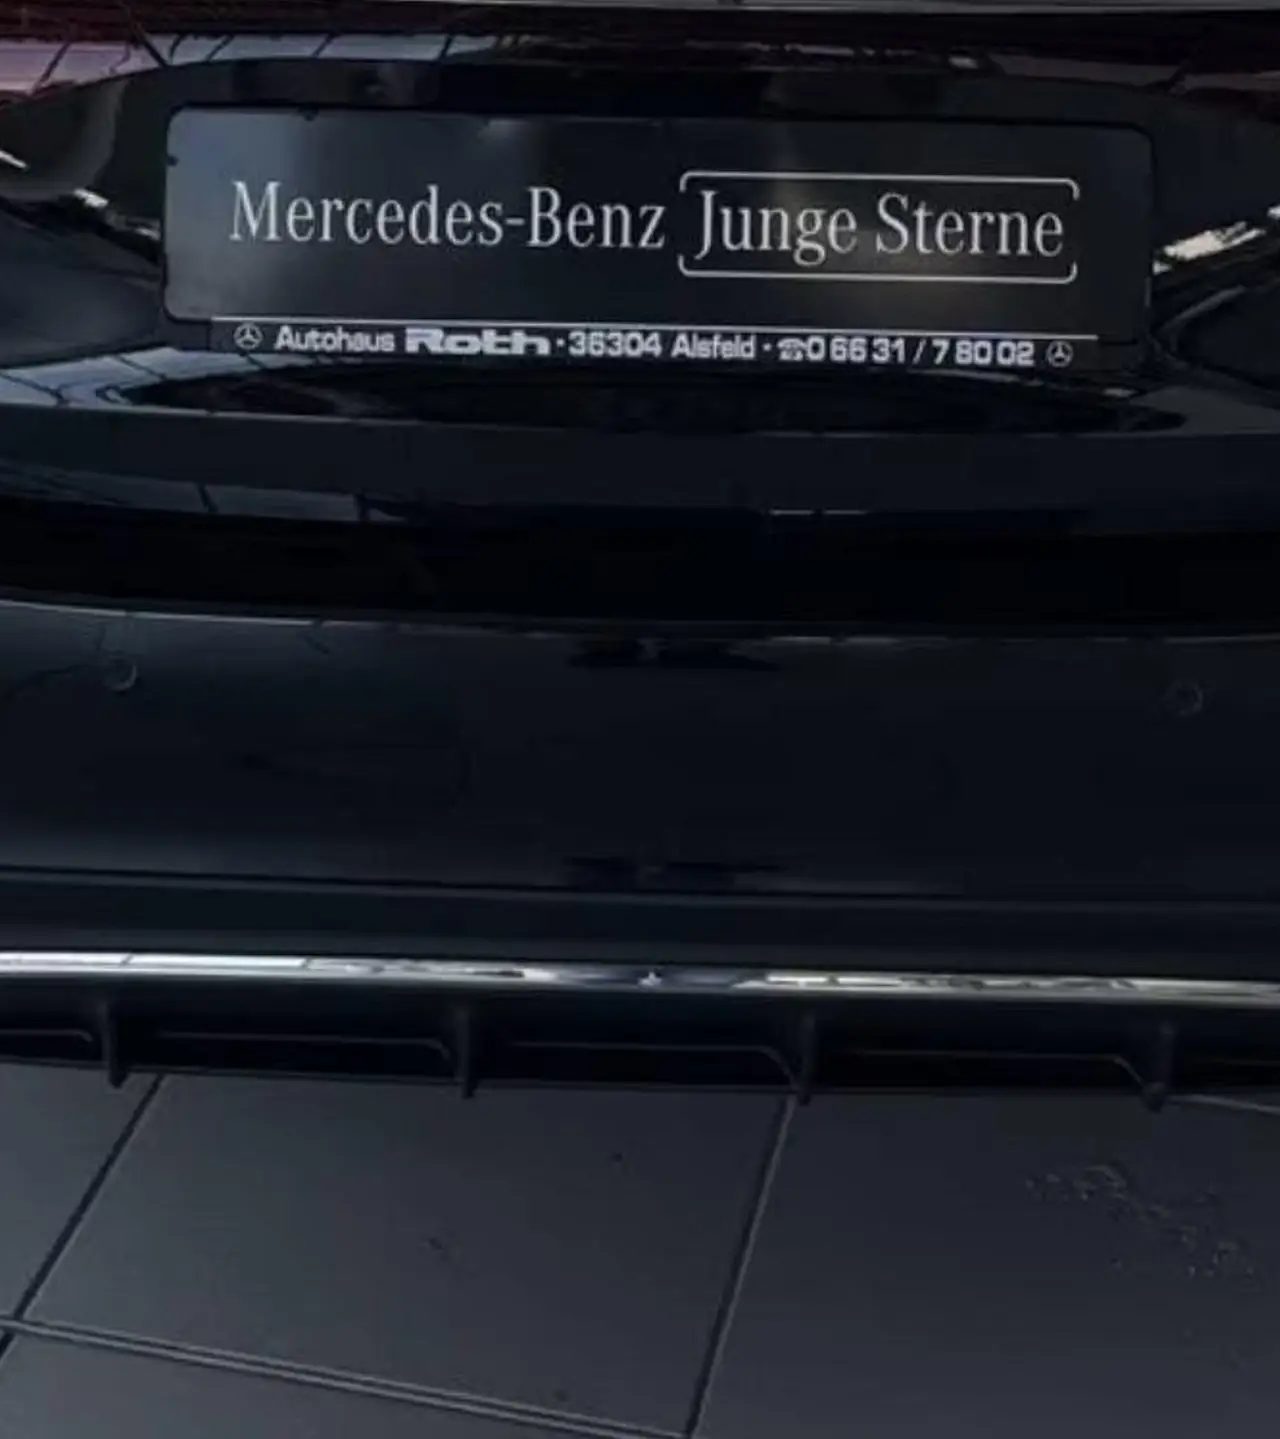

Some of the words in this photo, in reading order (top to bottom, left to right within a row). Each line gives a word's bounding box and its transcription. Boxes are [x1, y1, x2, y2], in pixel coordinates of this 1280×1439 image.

[228, 180, 667, 250] Mercedes-Benz
[694, 189, 858, 267] Junge
[874, 191, 1065, 258] Sterne
[274, 325, 396, 353] Autohaus
[405, 327, 551, 355] Roth
[568, 330, 663, 358] 36304
[671, 333, 757, 360] Alsfeld
